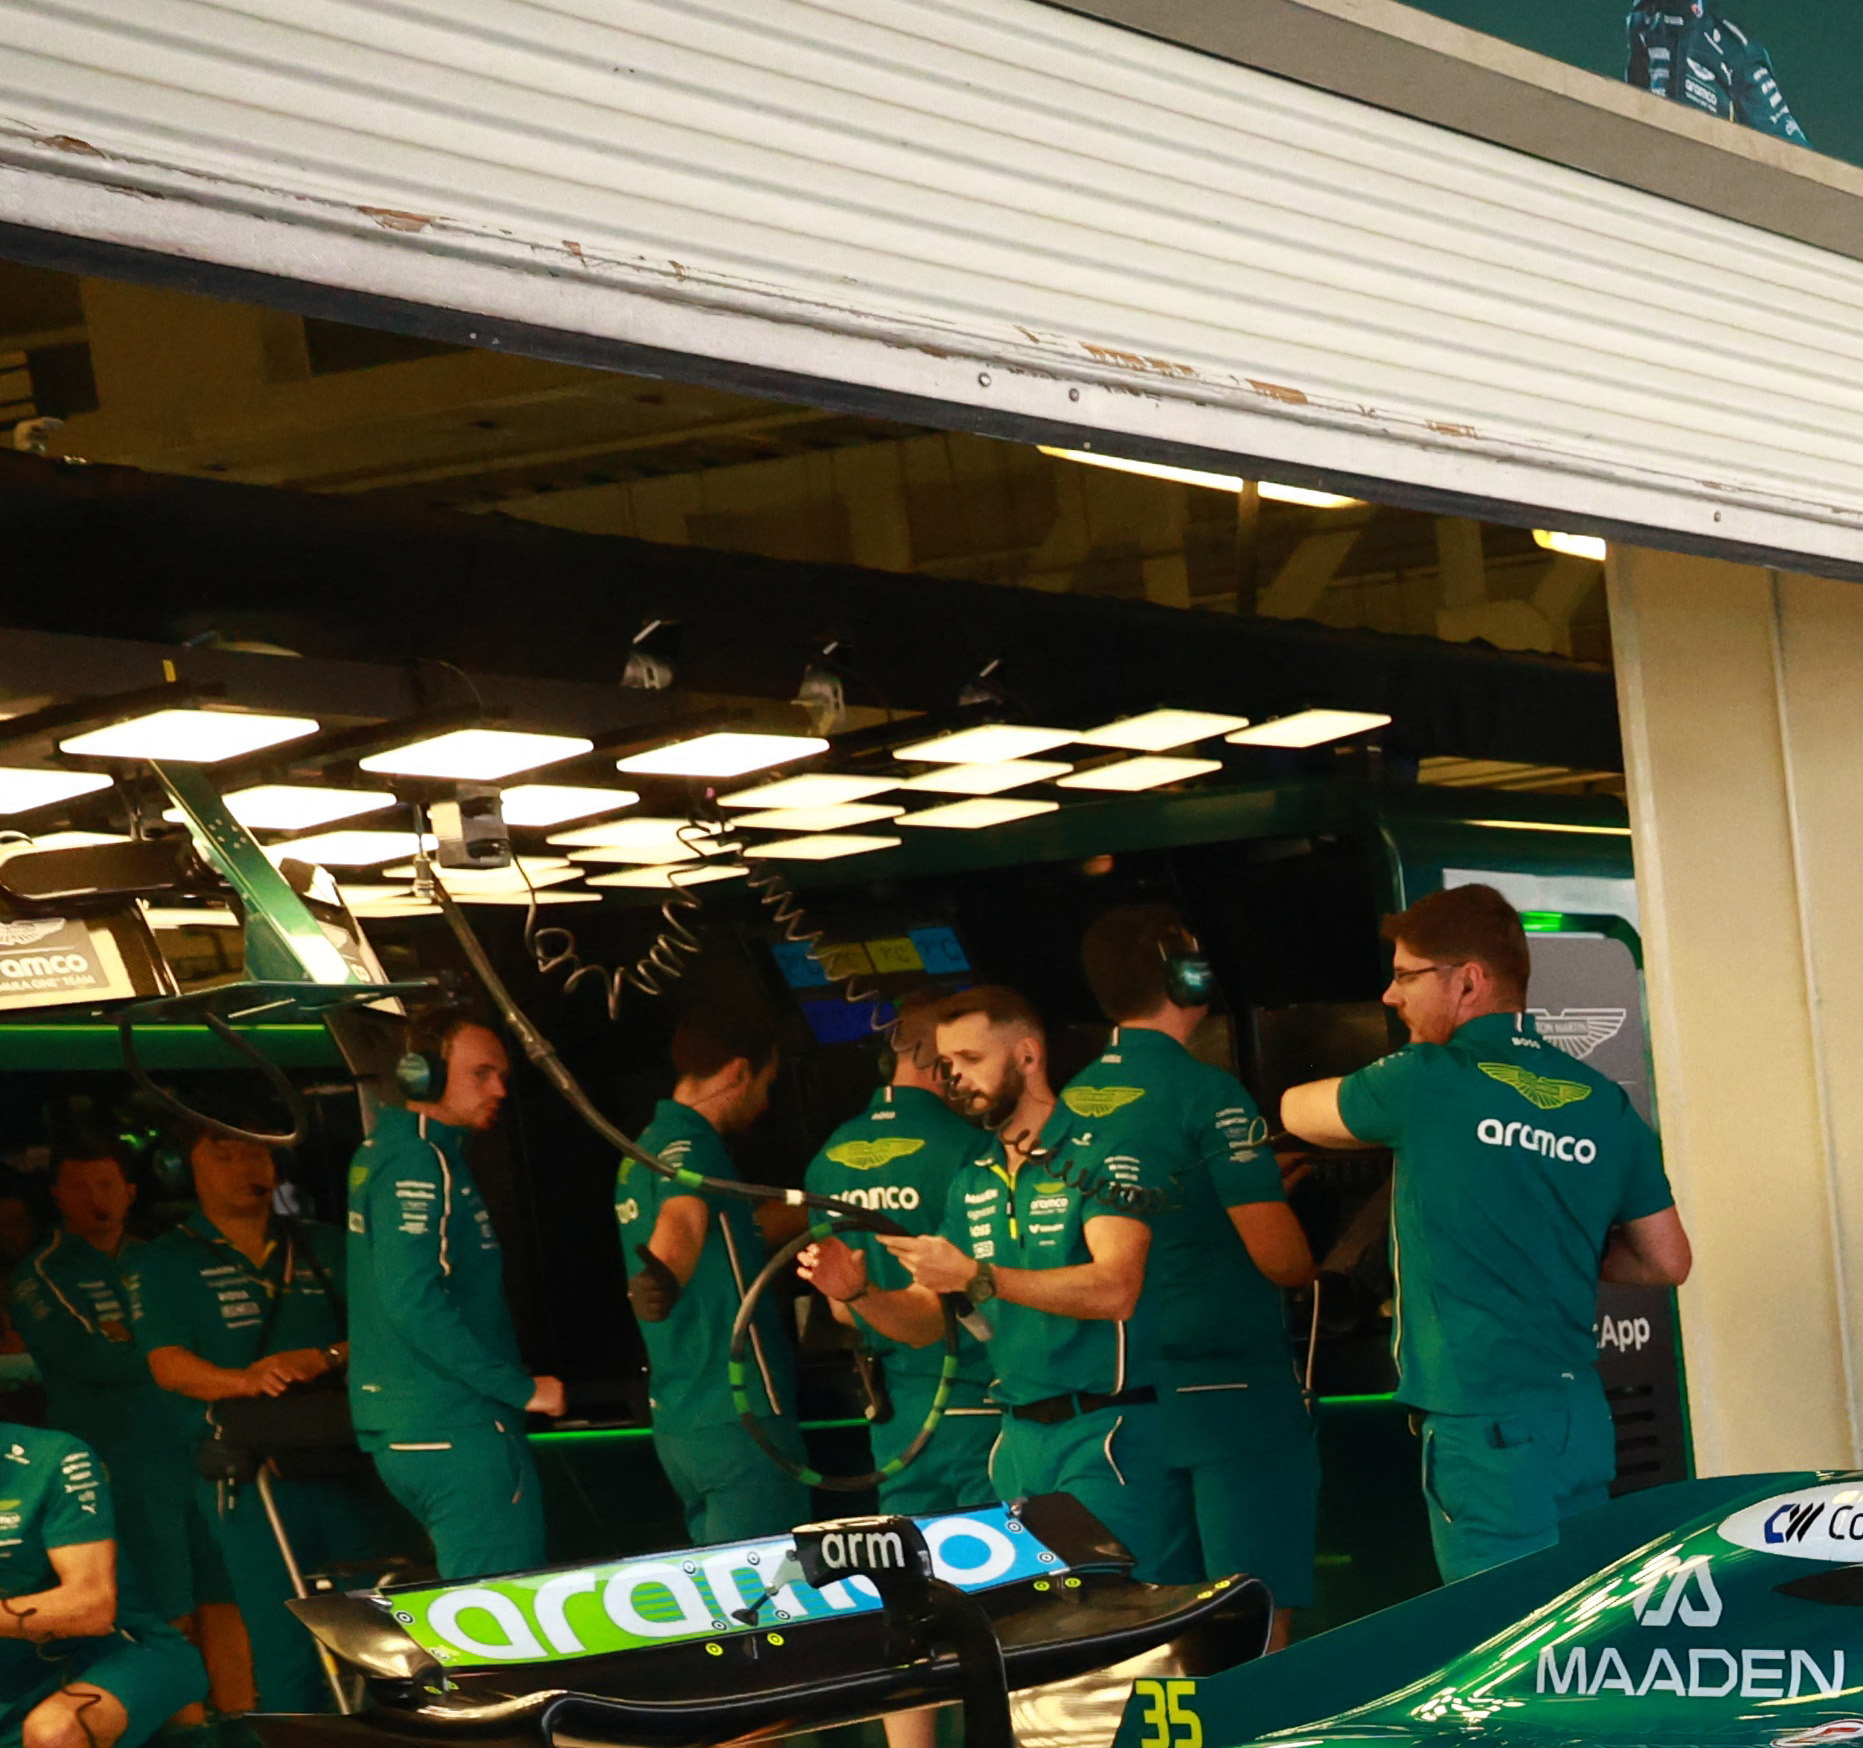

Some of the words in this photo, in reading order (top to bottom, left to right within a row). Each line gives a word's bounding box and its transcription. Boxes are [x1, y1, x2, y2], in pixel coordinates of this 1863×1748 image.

[1477, 1118, 1597, 1164] aramco
[1592, 1314, 1651, 1353] App
[821, 1529, 906, 1569] arm
[427, 1518, 1015, 1660] aramo
[1535, 1648, 1847, 1700] MAADEN
